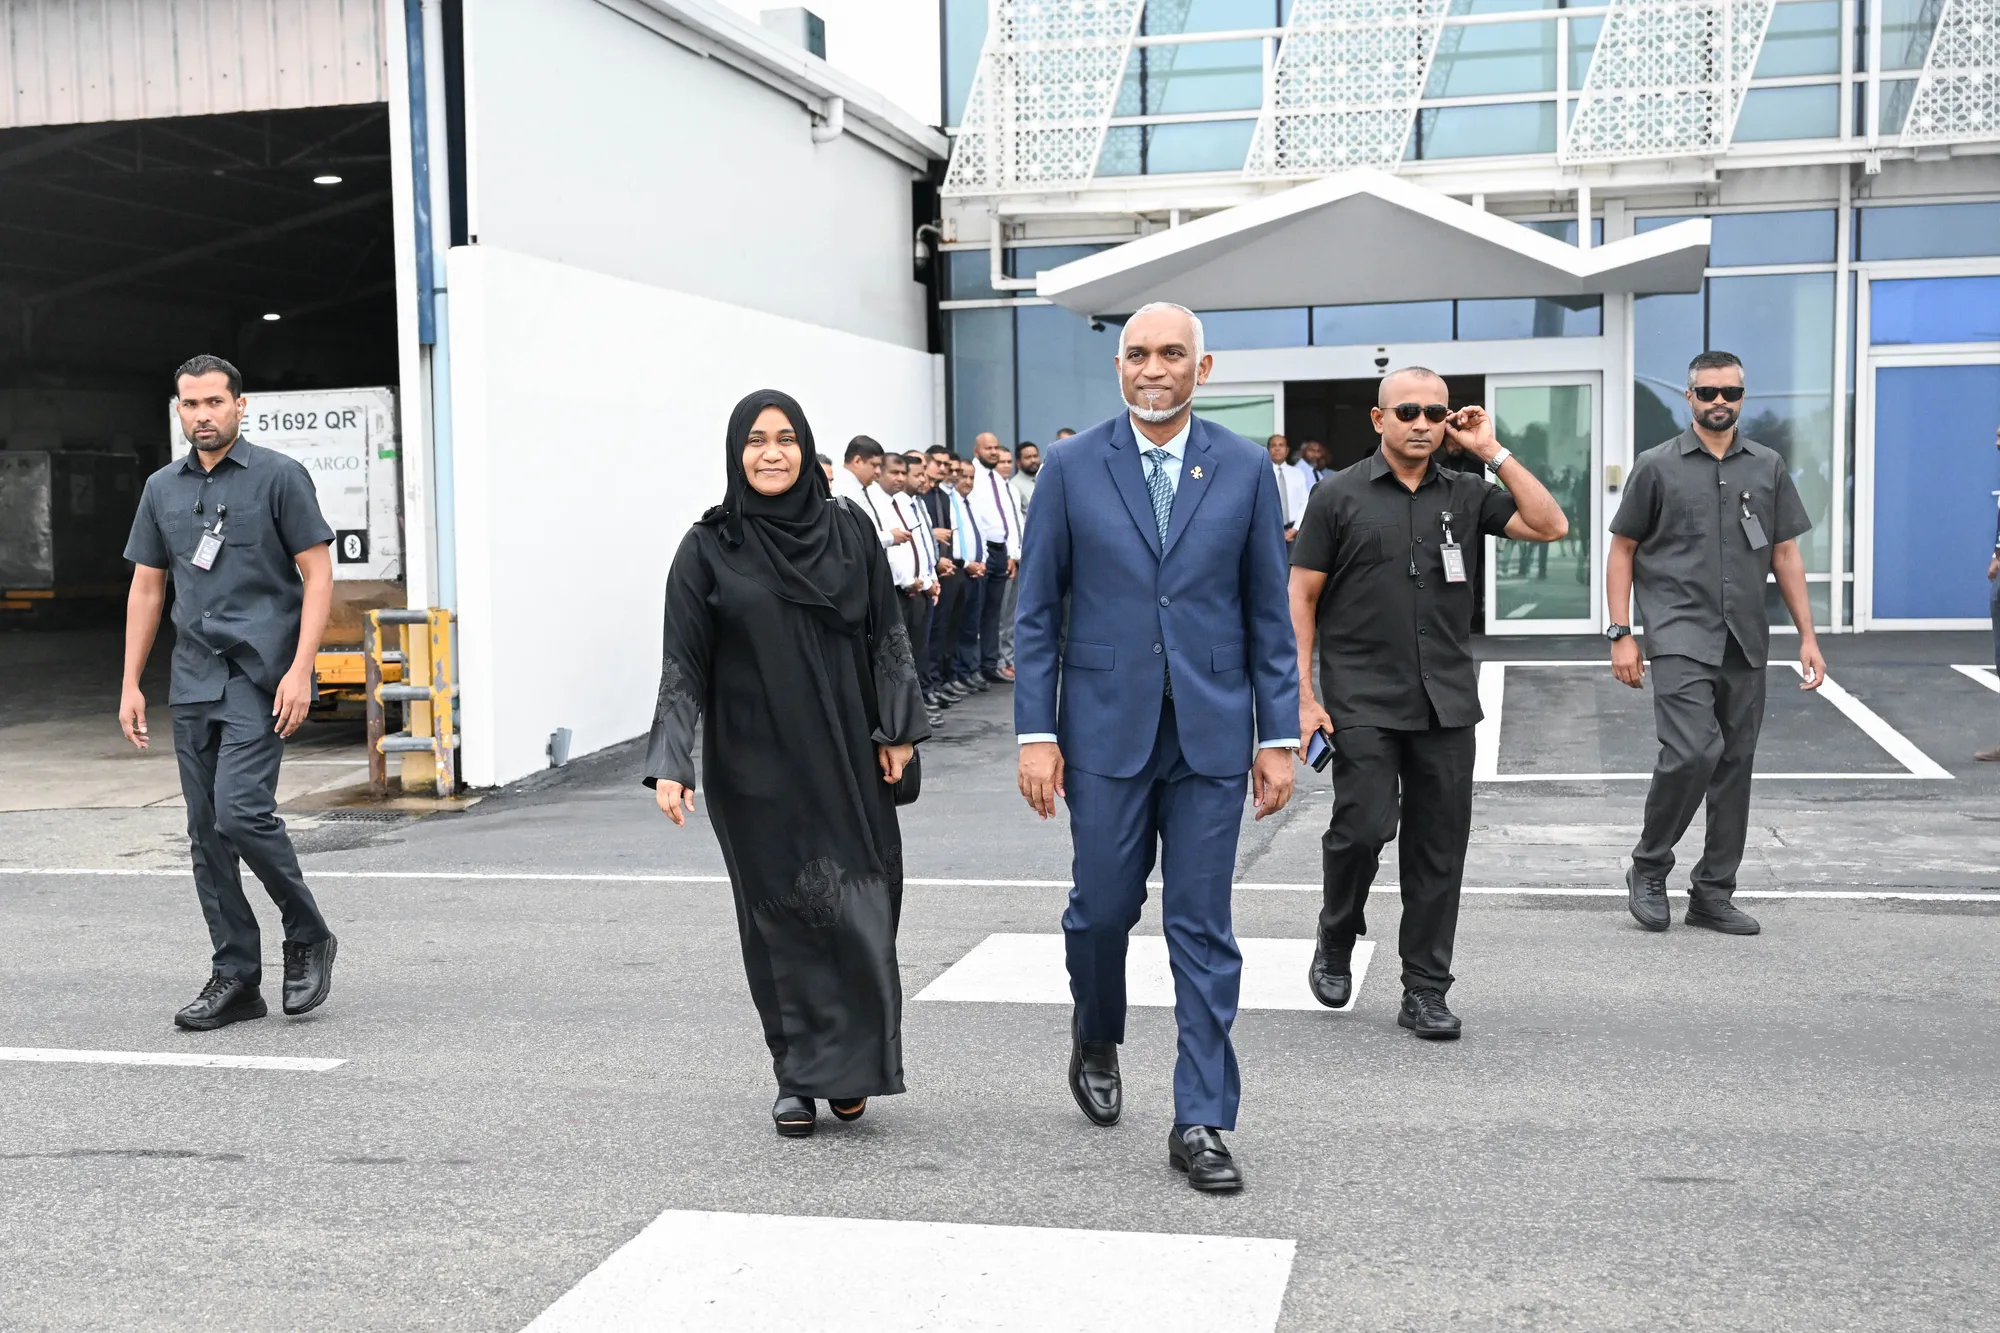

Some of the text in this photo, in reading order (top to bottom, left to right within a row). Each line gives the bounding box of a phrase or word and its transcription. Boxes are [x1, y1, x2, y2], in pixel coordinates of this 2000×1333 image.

[258, 412, 318, 431] 51692
[325, 410, 357, 430] QR
[302, 456, 359, 471] CARGO
